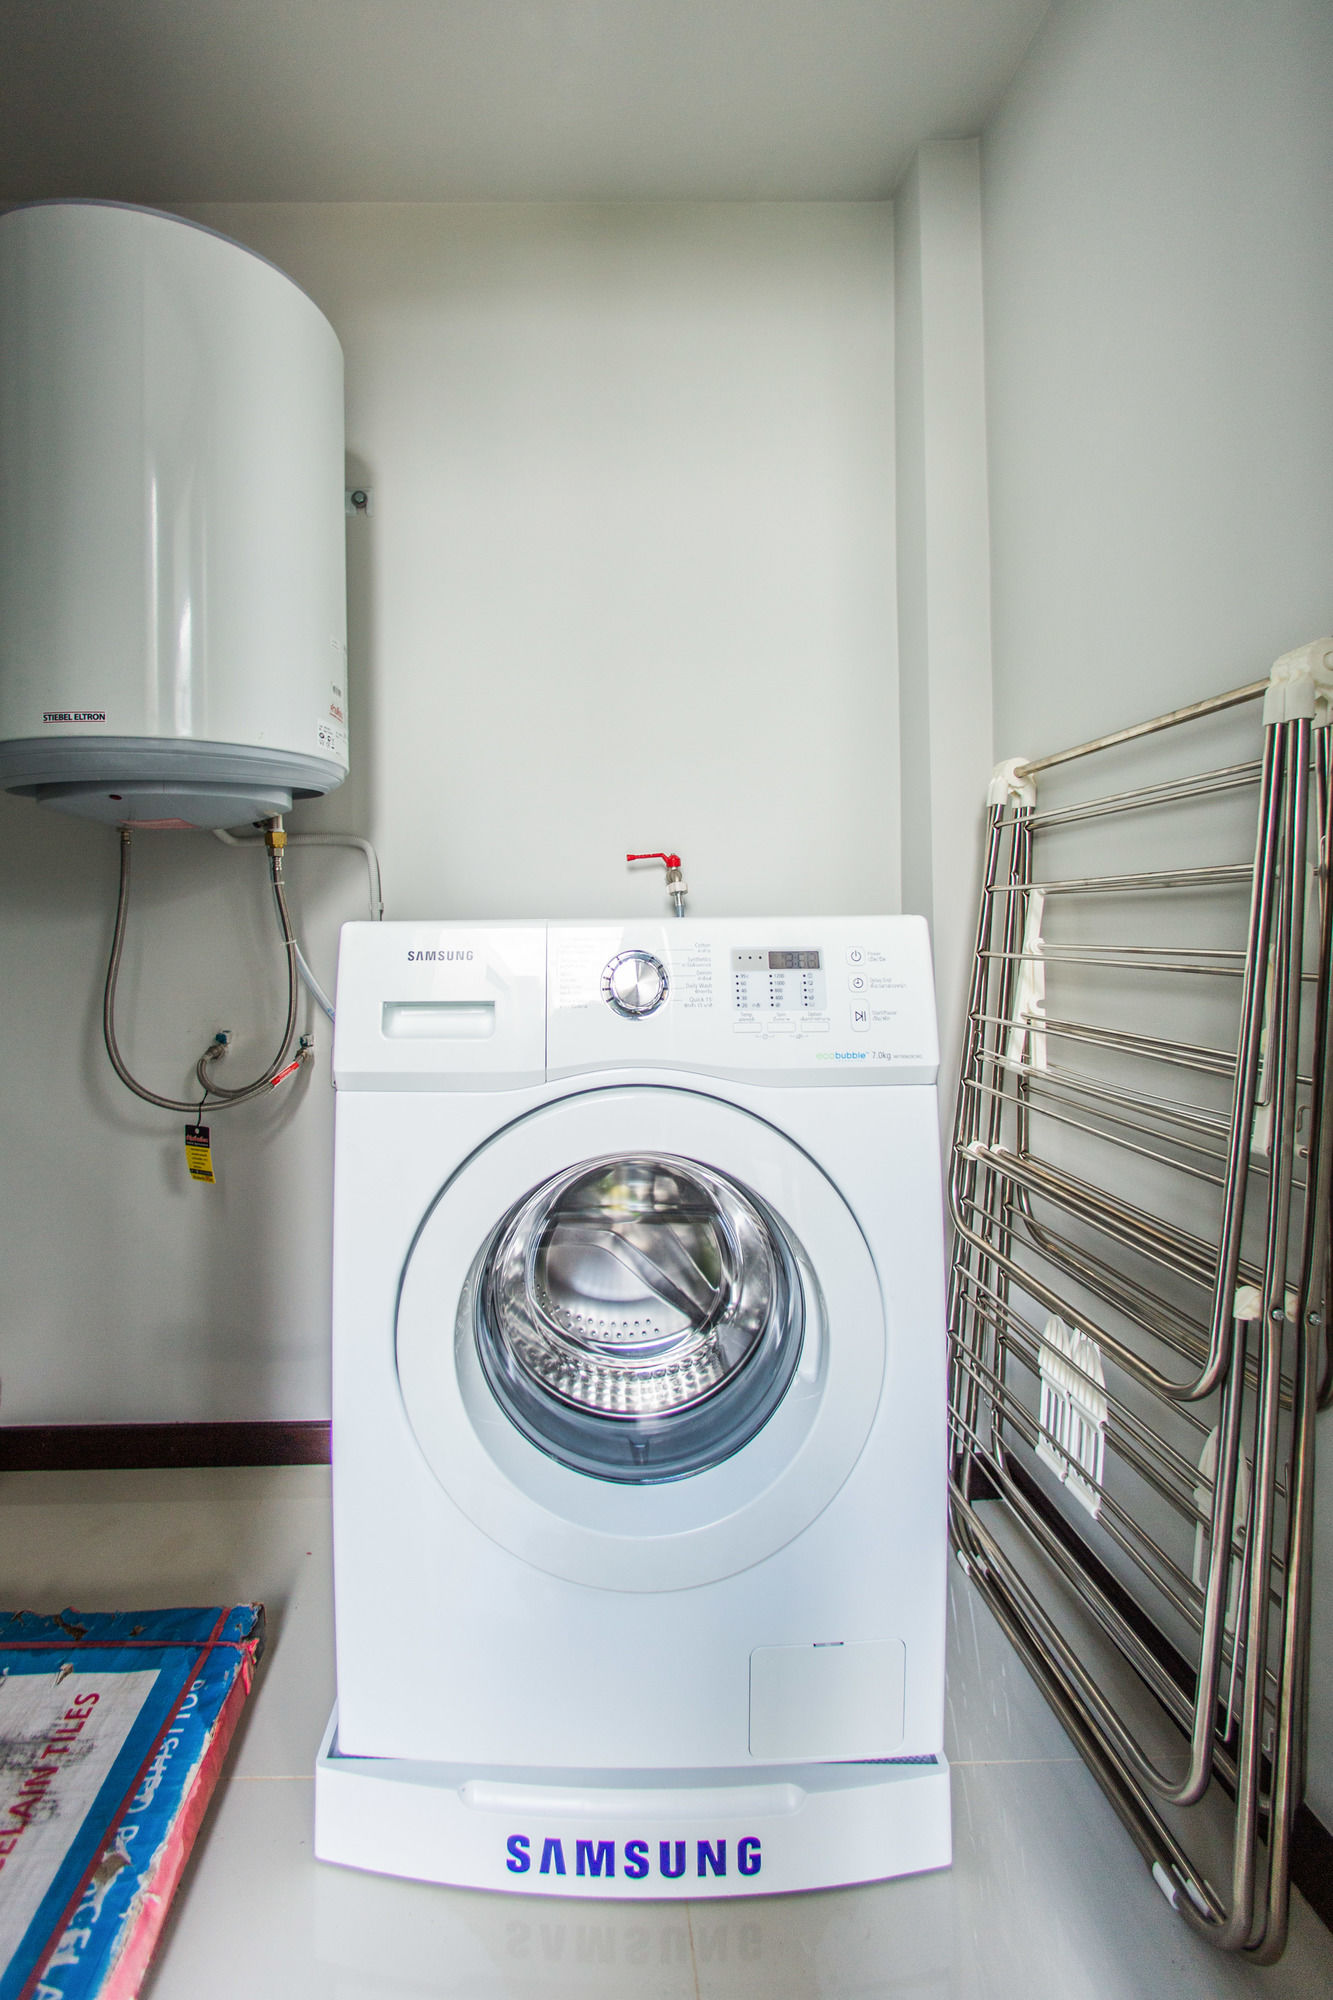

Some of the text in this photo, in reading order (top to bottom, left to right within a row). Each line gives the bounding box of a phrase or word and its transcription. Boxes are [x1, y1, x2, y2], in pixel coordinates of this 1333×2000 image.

[43, 713, 106, 721] STIEBEL ELTRON
[407, 950, 474, 961] SAMSUNG
[872, 1051, 892, 1061] 7.0kg
[0, 1693, 100, 1872] ELAIN TILES
[506, 1834, 763, 1879] SAMSUNG
